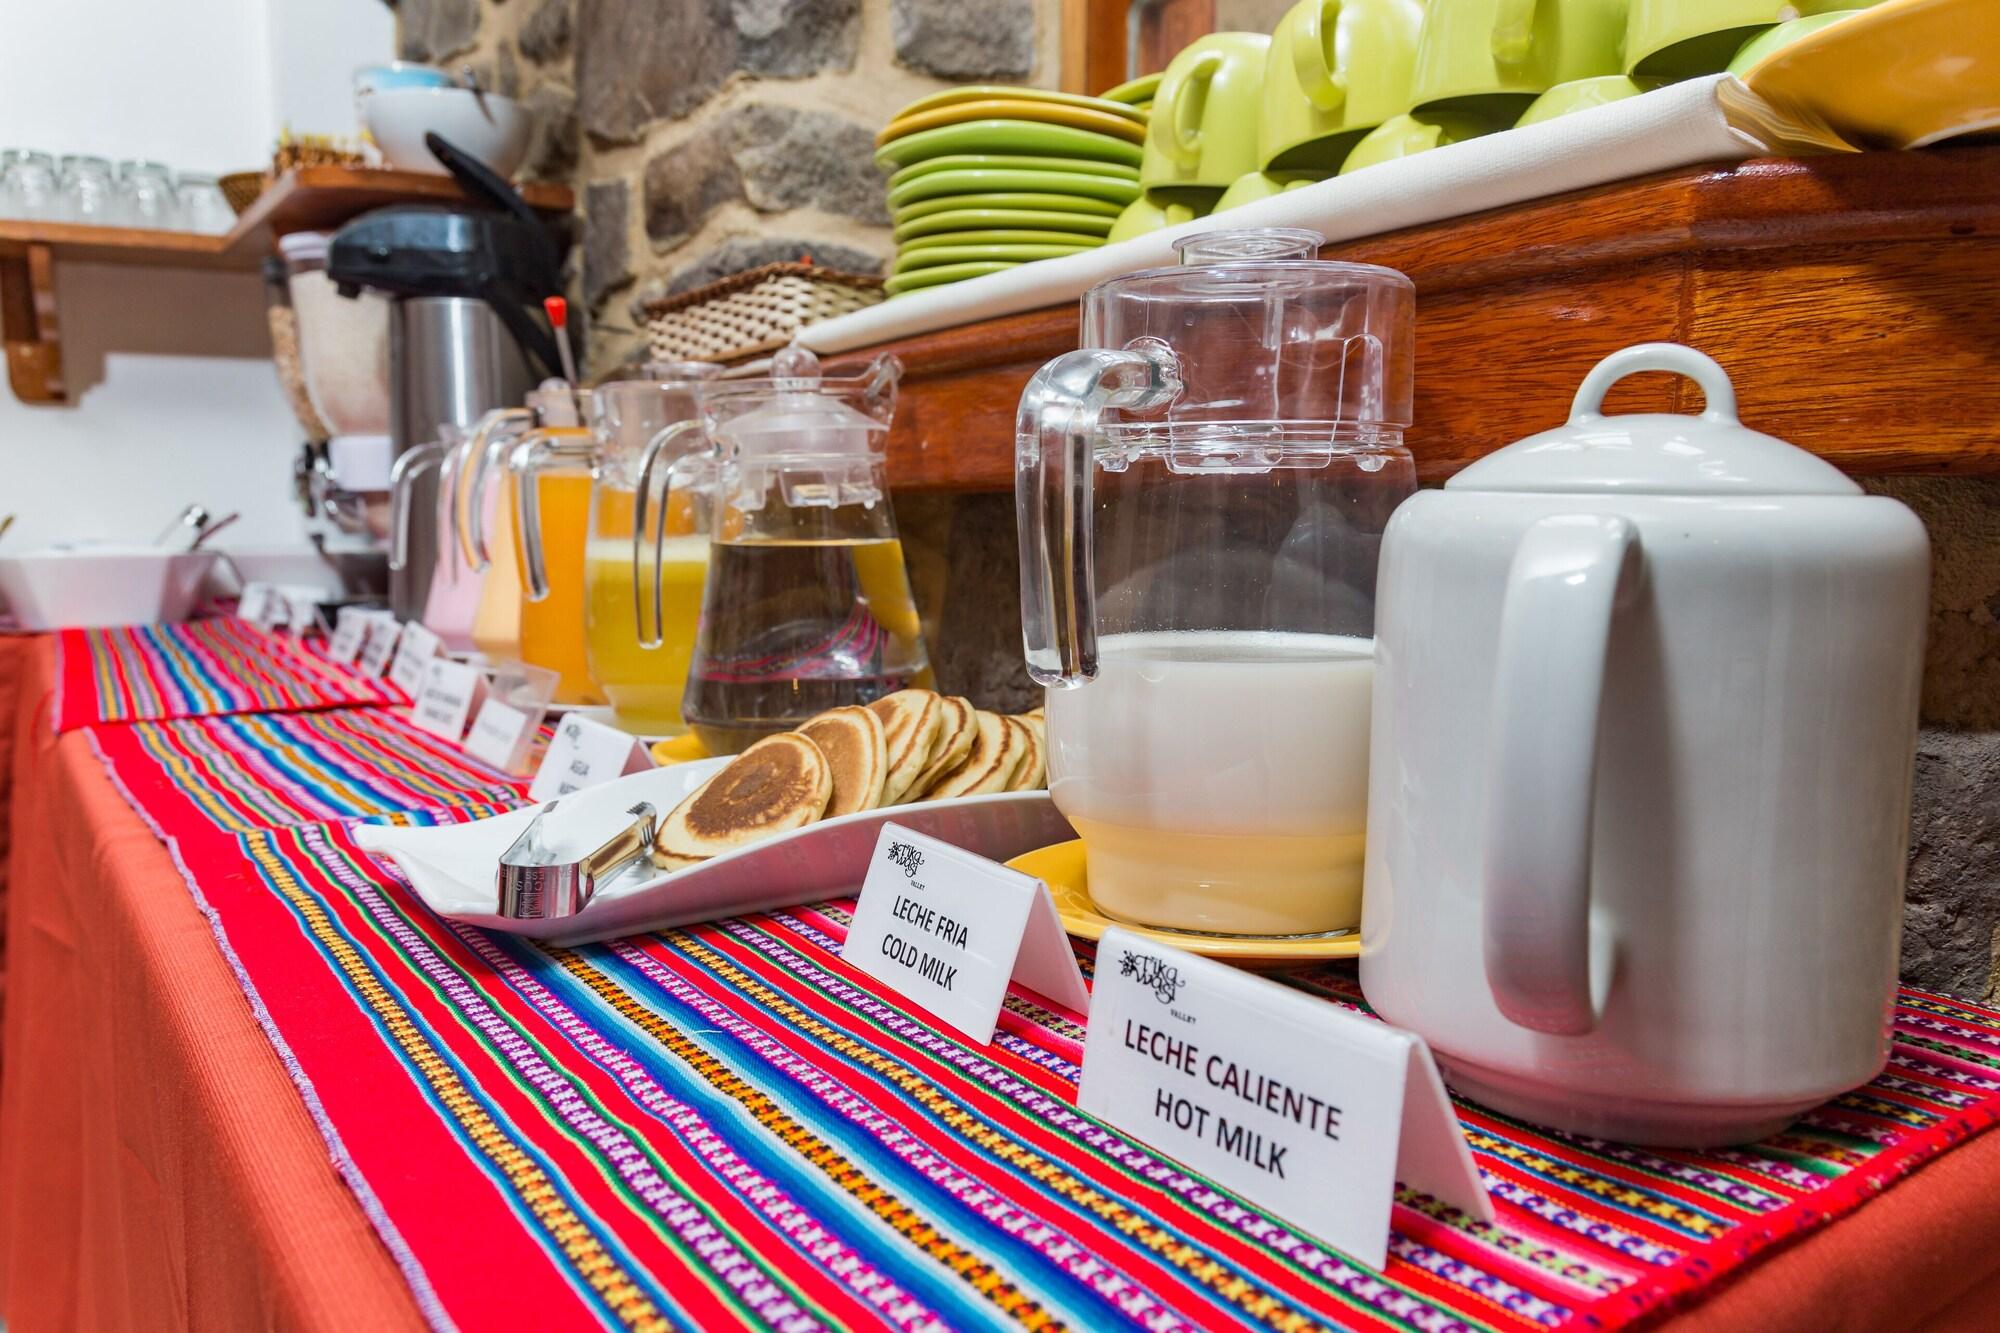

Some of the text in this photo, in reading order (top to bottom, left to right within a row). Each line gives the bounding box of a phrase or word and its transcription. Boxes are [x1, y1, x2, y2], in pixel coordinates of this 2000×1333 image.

[892, 895, 969, 951] LECHE FRIA
[881, 933, 958, 991] COLD MILK
[1170, 1008, 1197, 1025] VALLEY
[1124, 1019, 1342, 1141] LECHE CALIENTE
[1154, 1087, 1289, 1178] HOT MILK
